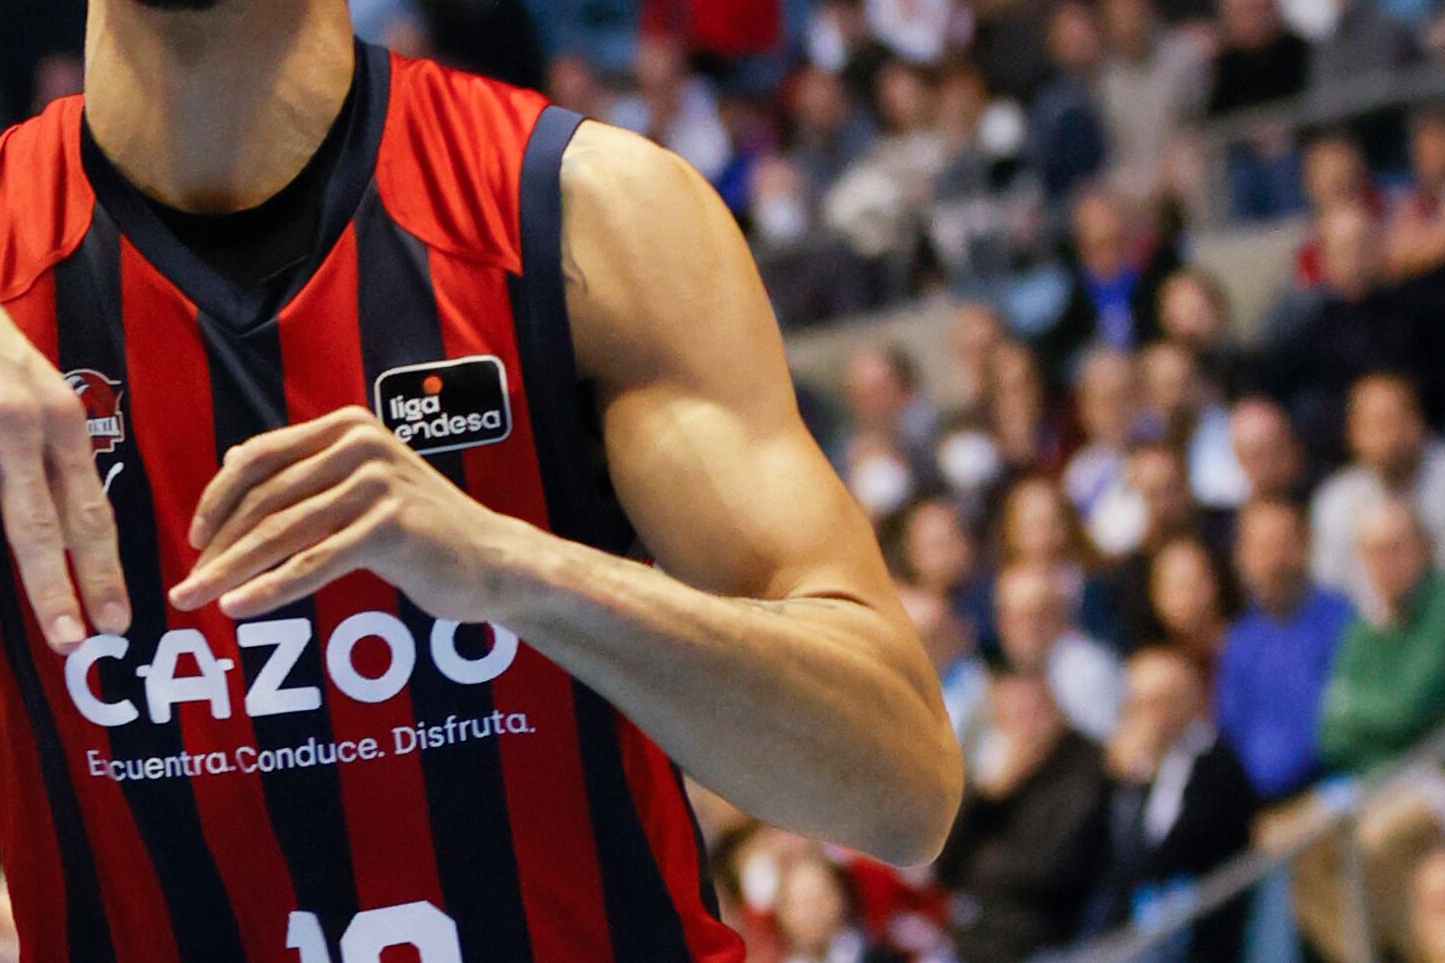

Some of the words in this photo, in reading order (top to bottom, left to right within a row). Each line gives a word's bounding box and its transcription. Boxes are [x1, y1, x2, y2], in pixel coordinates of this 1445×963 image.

[390, 394, 441, 422] liga
[393, 410, 502, 443] endesa
[64, 610, 519, 727] CAZOO
[234, 736, 386, 774] Conduce.
[392, 708, 536, 755] Disfruta.
